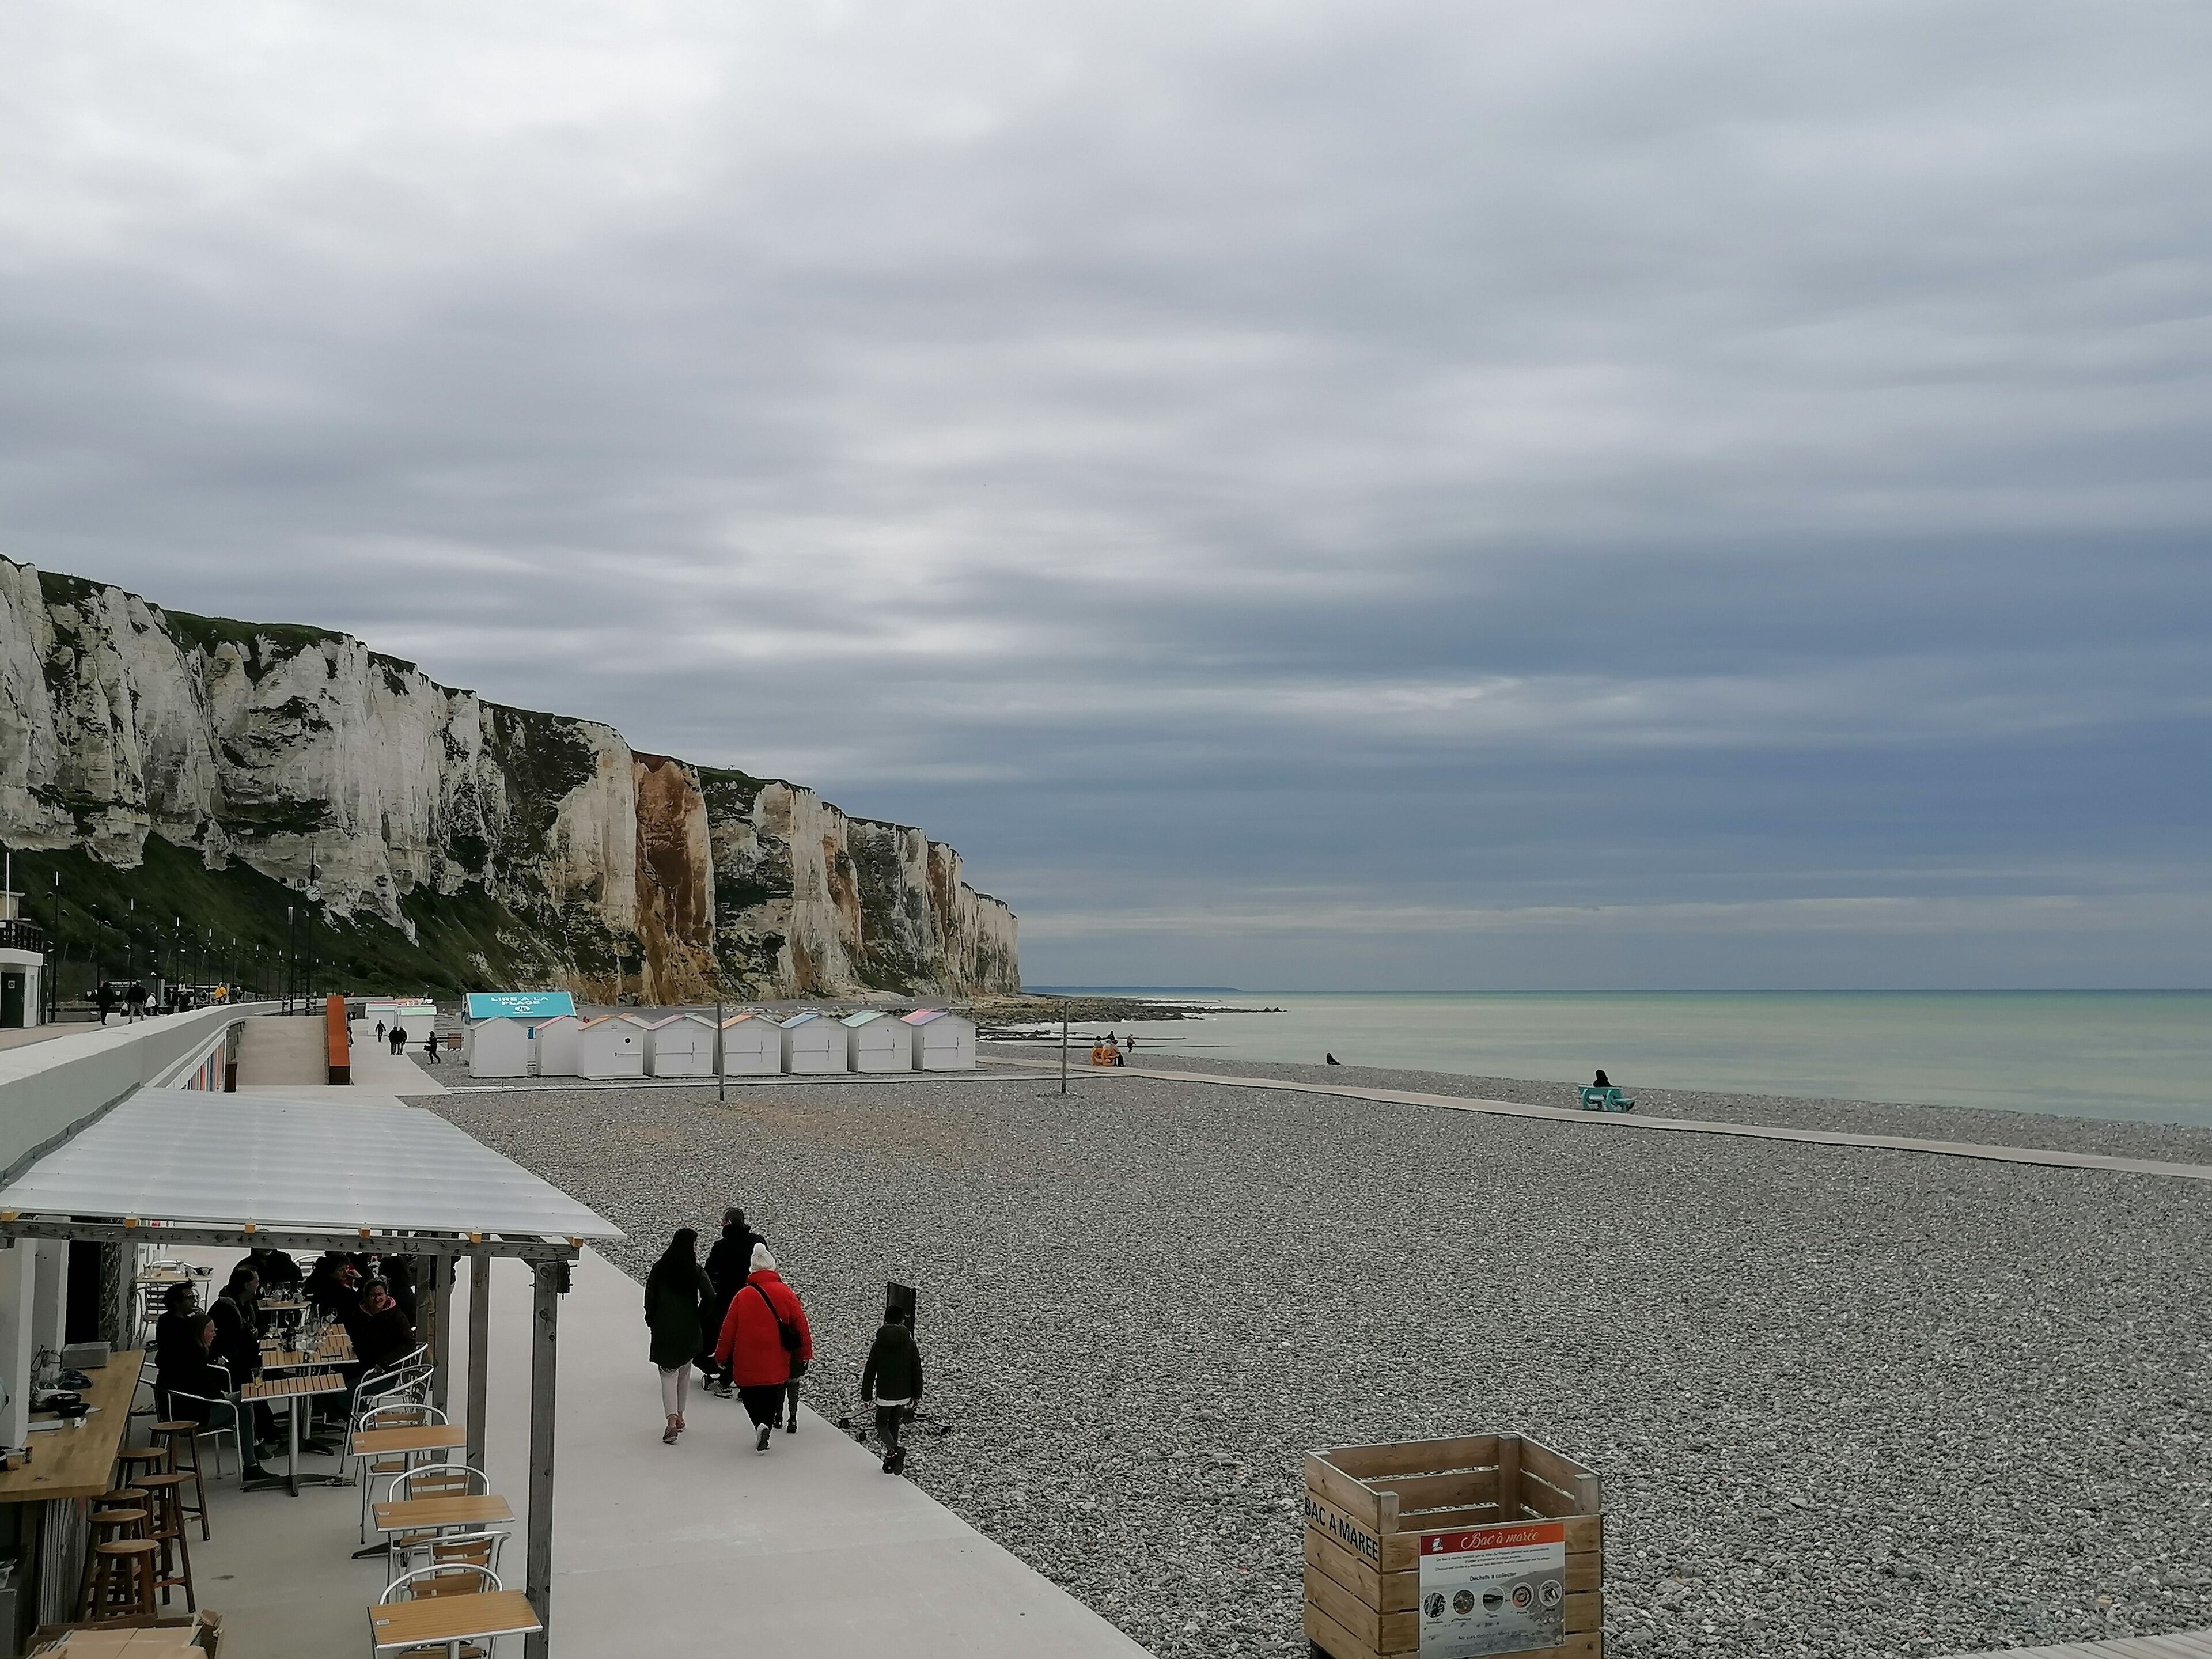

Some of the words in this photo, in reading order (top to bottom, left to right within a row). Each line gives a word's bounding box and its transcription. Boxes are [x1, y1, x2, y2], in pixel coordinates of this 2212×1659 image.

[1305, 1497, 1325, 1527] BAC
[1329, 1513, 1337, 1535] A
[1339, 1518, 1378, 1562] MAREE
[1461, 1532, 1495, 1549] Bac
[1496, 1532, 1503, 1544] à
[1506, 1529, 1539, 1543] marée
